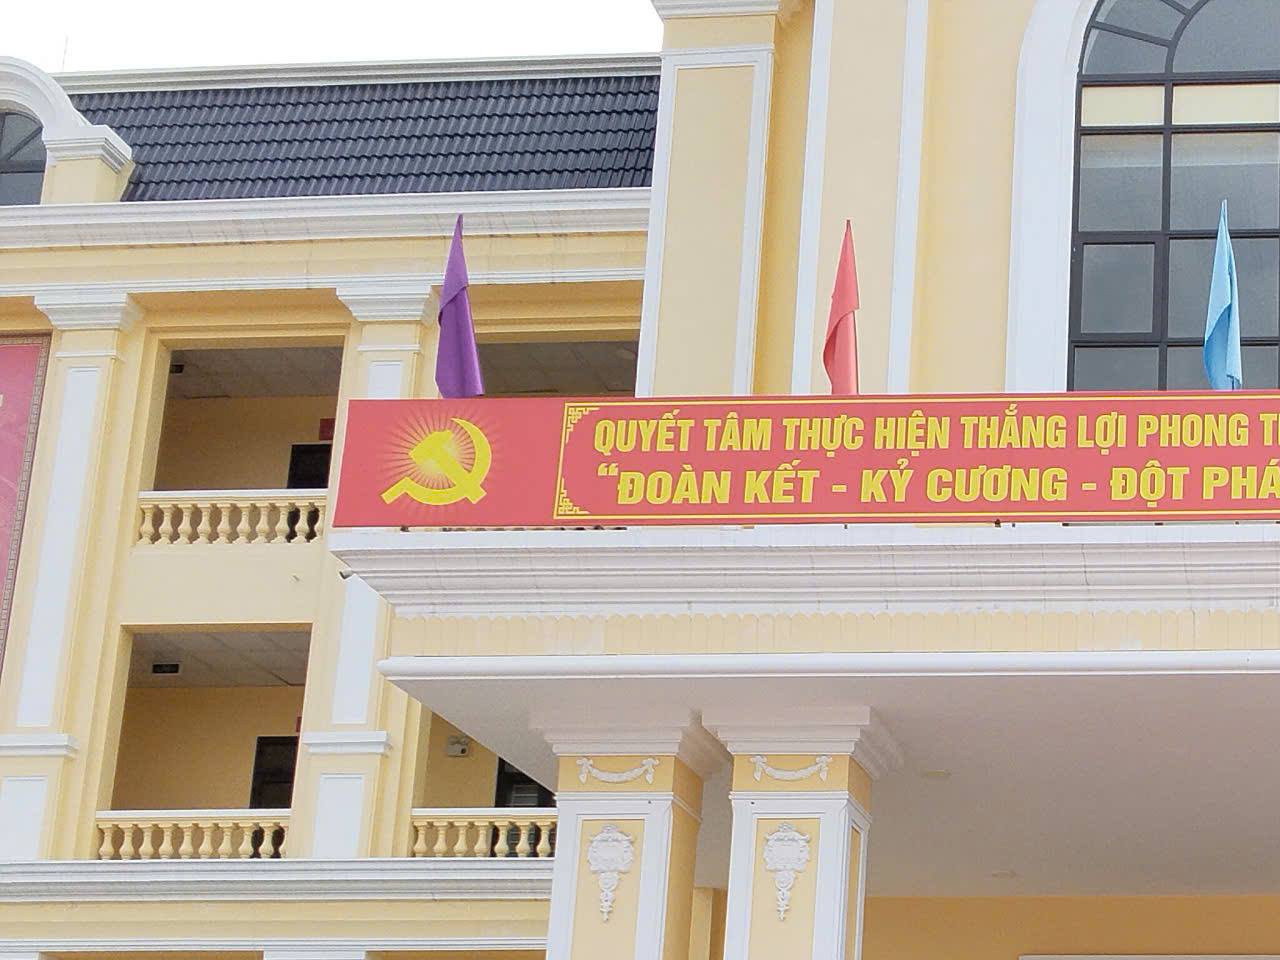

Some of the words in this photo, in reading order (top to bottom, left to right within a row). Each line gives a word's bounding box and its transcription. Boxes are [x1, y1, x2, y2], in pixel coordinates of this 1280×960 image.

[594, 409, 694, 455] QUYẾT
[703, 412, 772, 450] TÂM
[783, 412, 865, 457] THỰC
[874, 410, 949, 457] HIỆN
[959, 403, 1066, 449] THẮNG
[1076, 411, 1126, 456] LỢI
[1137, 412, 1249, 447] PHONG
[598, 462, 731, 504] “ĐOÀN
[743, 460, 819, 503] KẾT
[859, 457, 914, 502] KỶ
[926, 464, 1067, 502] CƯƠNG
[1109, 459, 1189, 507] ĐỘT
